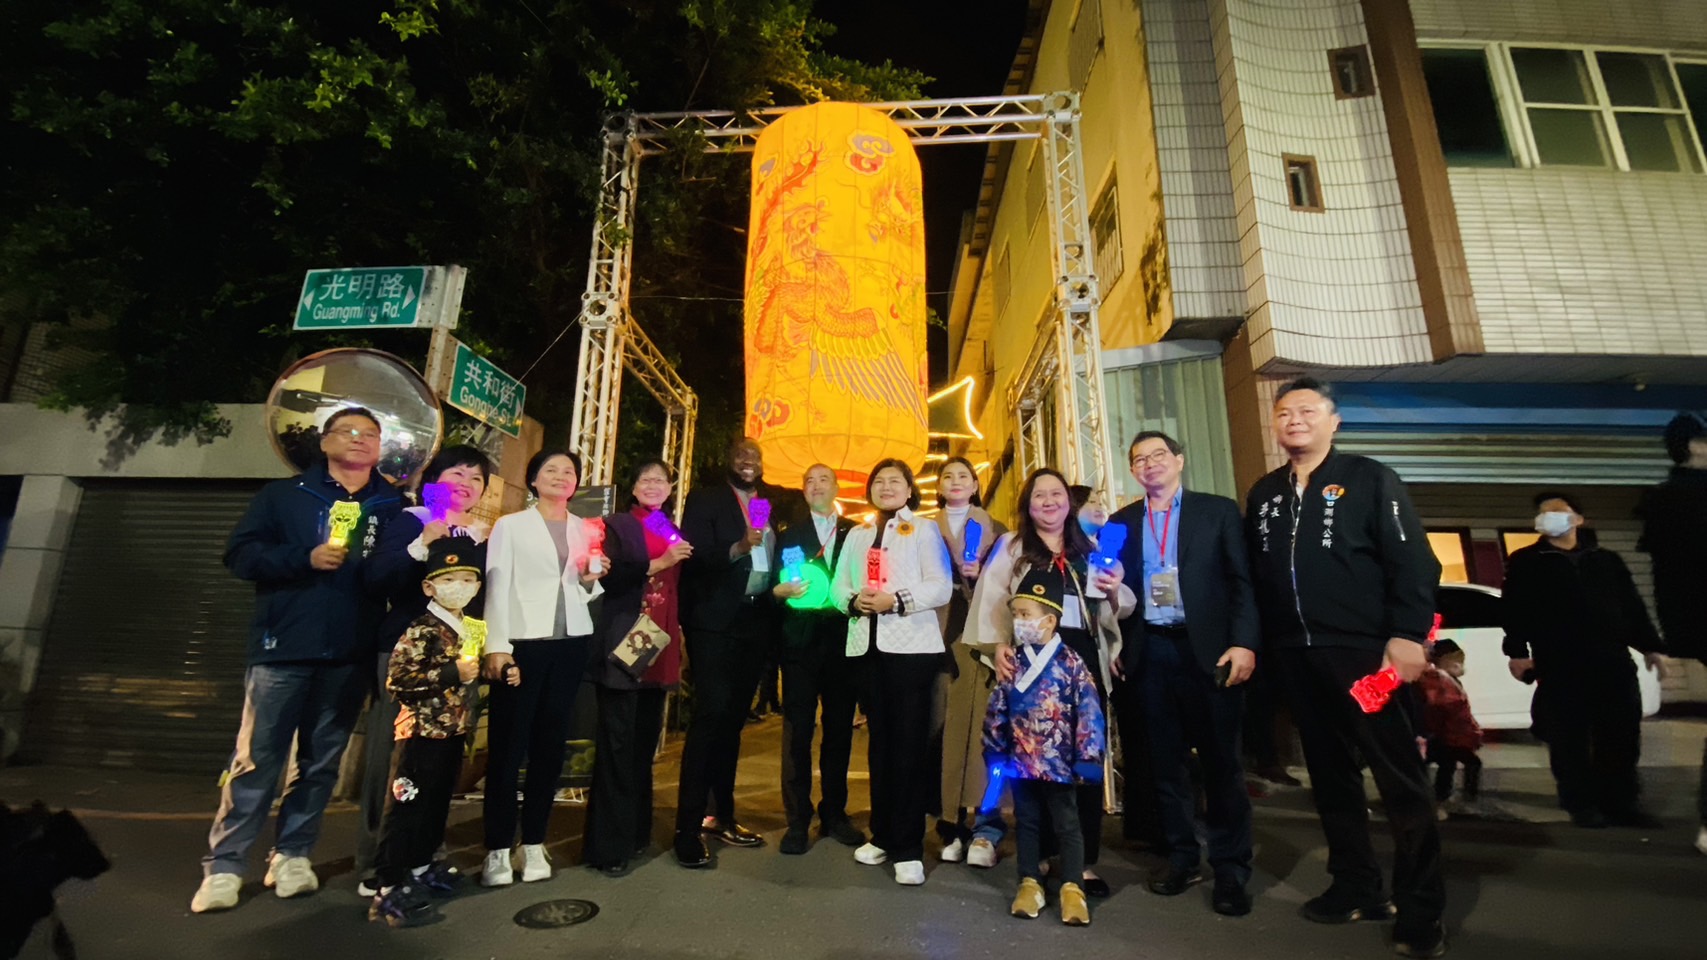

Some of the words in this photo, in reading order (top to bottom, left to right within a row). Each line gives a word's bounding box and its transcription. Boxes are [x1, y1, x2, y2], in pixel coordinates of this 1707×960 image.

[318, 273, 405, 301] 光明路
[313, 303, 379, 324] Guangming
[381, 301, 401, 319] Rd.
[463, 360, 516, 408] 共和街
[460, 386, 499, 419] Gonghe
